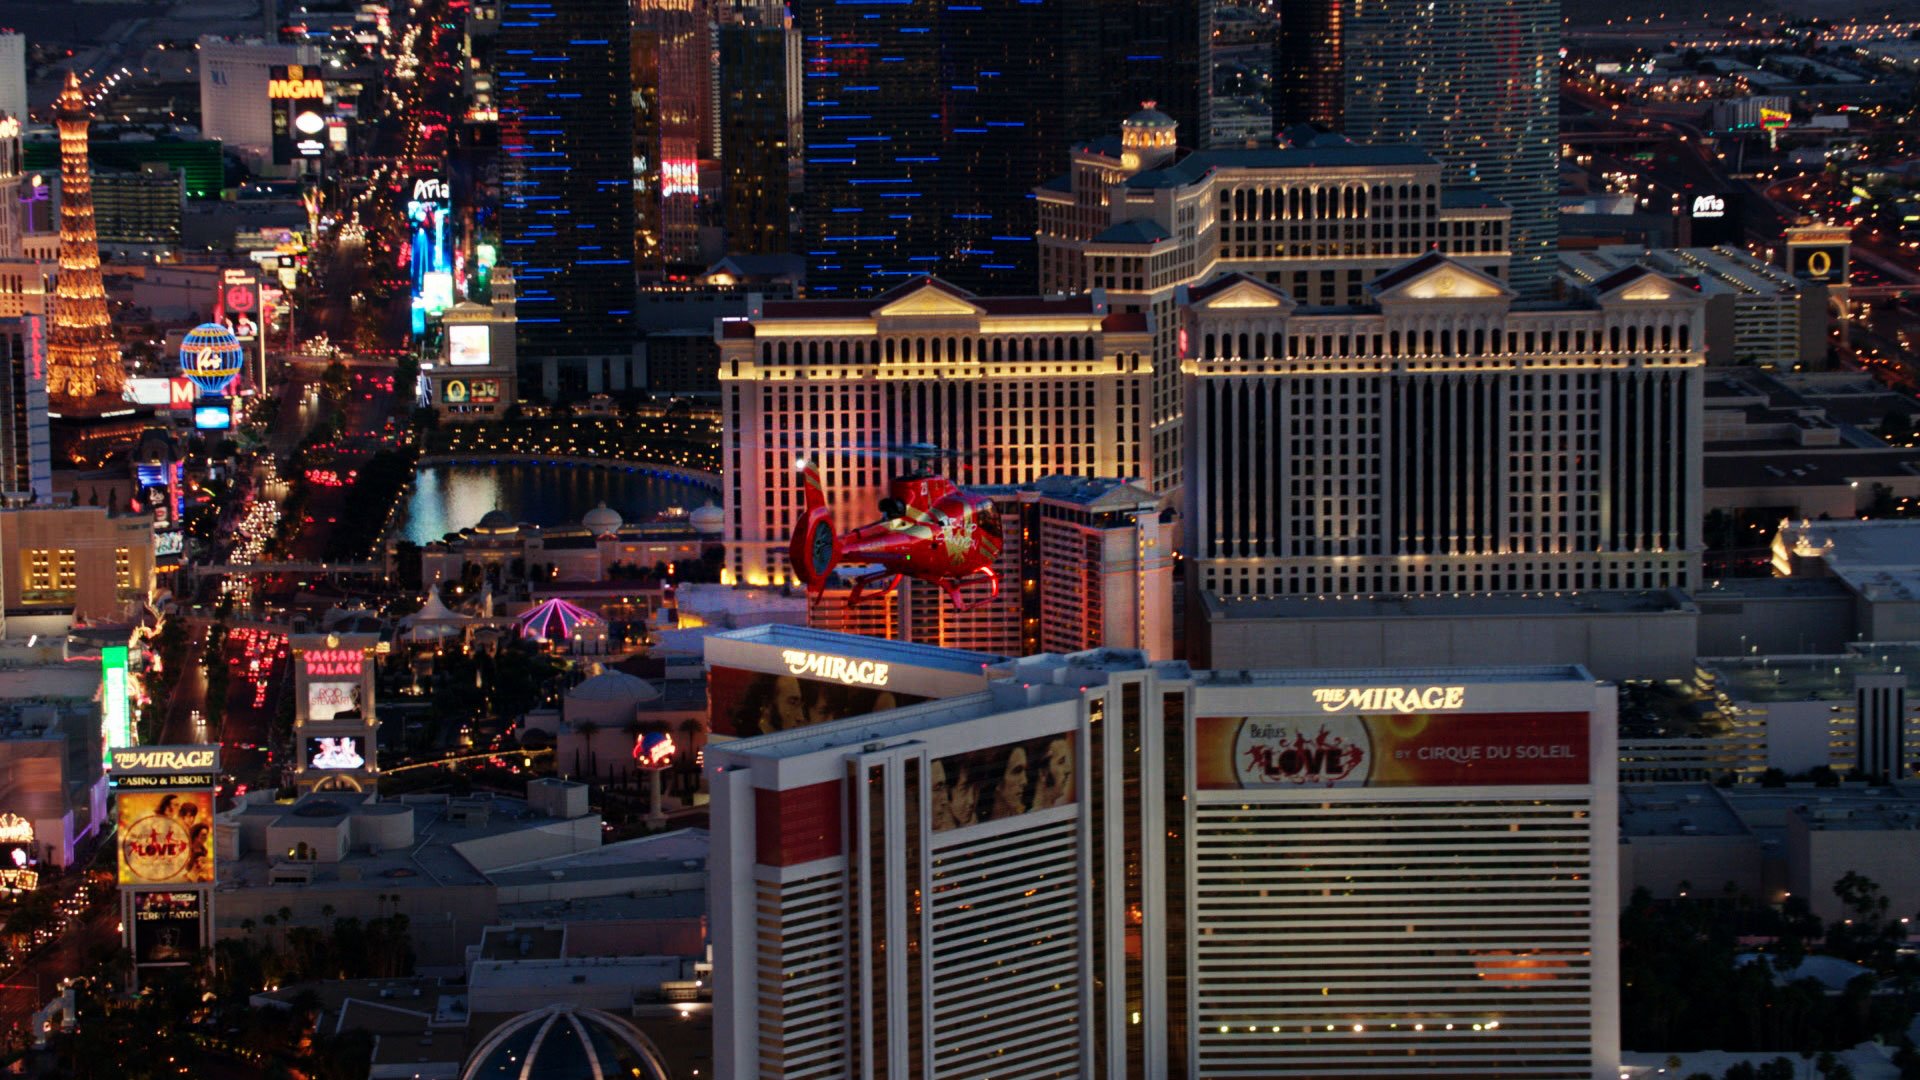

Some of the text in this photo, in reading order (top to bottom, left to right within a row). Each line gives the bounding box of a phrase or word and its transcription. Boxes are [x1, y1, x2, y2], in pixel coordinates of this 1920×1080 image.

[268, 79, 324, 98] MGM
[413, 178, 449, 200] Aria
[1693, 195, 1725, 212] Aria
[304, 650, 364, 662] CAESARS
[306, 663, 362, 675] PALACE
[789, 653, 888, 686] MIRAGE
[319, 688, 342, 698] ROD
[1312, 687, 1464, 712] THE MIRAGE
[114, 751, 215, 769] THE MIRAGE
[1264, 748, 1343, 775] LOVE
[1417, 746, 1481, 763] CIRQUE
[1486, 747, 1510, 759] DU
[1515, 745, 1576, 759] SOLEIL
[118, 775, 211, 786] CASINO & RESORT
[138, 843, 176, 856] LOVE
